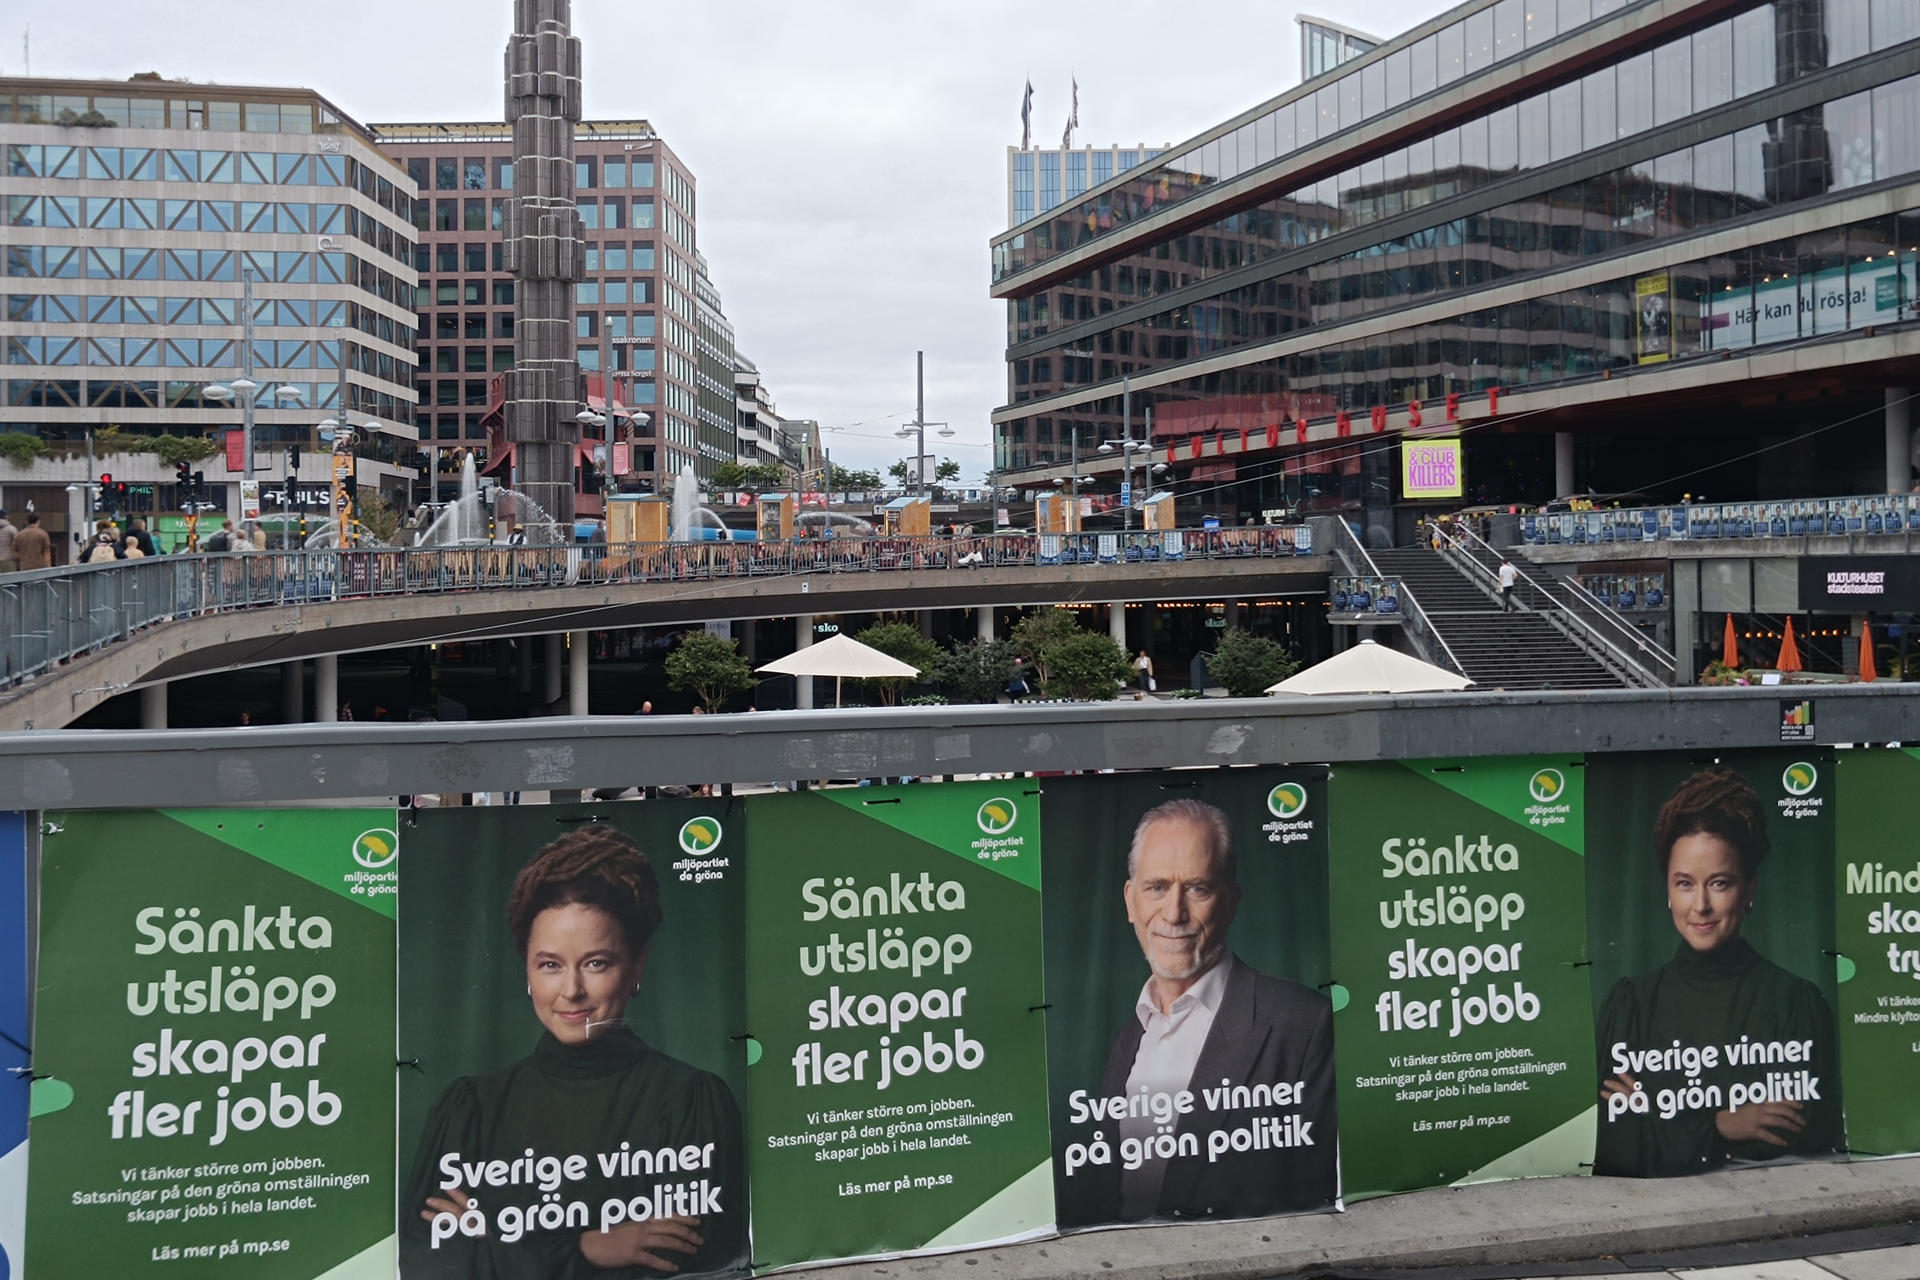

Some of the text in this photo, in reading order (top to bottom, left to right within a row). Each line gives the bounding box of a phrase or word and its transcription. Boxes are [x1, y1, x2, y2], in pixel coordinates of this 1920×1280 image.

[1735, 309, 1760, 325] Här
[1765, 301, 1791, 319] kan
[1799, 297, 1815, 313] du
[1167, 386, 1500, 462] KULTURHUSET
[1409, 451, 1454, 465] & CLUB
[1409, 465, 1455, 486] KILLERS
[26, 499, 35, 512] 4
[1827, 571, 1885, 583] KULTURHUSET
[1827, 583, 1884, 594] stadsteatern
[818, 622, 838, 632] sko
[1524, 805, 1570, 817] miljöpartiet
[1778, 798, 1823, 810] miljöpartiet
[1783, 807, 1818, 819] de gröna
[1262, 820, 1313, 834] miljöpartiet
[1529, 815, 1565, 827] de gröna
[971, 836, 1024, 852] miljöpartiet
[1268, 831, 1308, 844] de gröna
[673, 857, 729, 872] miljöpartiet
[978, 848, 1018, 861] de gröna
[1381, 835, 1518, 878] Sänkta
[351, 883, 365, 894] de
[679, 870, 723, 883] de gröna
[802, 872, 966, 921] Sänkta
[1379, 885, 1525, 932] utsläpp
[135, 904, 332, 955] Sänkta
[1868, 902, 1920, 934] ska
[800, 927, 972, 977] utsläpp
[1388, 938, 1522, 984] skapar
[1887, 943, 1920, 981] try
[127, 965, 336, 1021] utsläpp
[1877, 996, 1888, 1007] Vi
[808, 986, 967, 1033] skapar
[1375, 982, 1540, 1037] fler jobb
[1854, 1012, 1889, 1024] Mindre
[132, 1028, 326, 1082] skapar
[792, 1029, 985, 1090] fler jobb
[1390, 1047, 1534, 1067] Vi tänker större om jobben.
[1611, 1035, 1813, 1077] Sverige vinner
[1356, 1060, 1566, 1088] Satsningar på den gröna omställningen
[1069, 1078, 1305, 1124] Sverige vinner
[1395, 1080, 1530, 1102] skapar jobb i hela landet.
[1608, 1070, 1821, 1122] på grön politik
[108, 1079, 342, 1145] fler jobb
[807, 1098, 975, 1125] Vi tänker större om jobben.
[1413, 1115, 1511, 1132] Läs mer på mp.se
[768, 1111, 1013, 1149] Satsningar på den gröna omställningen
[815, 1134, 971, 1163] skapar jobb i hela landet.
[1065, 1114, 1314, 1177] på grön politik
[121, 1156, 325, 1182] Vi tänker större om jobben.
[440, 1141, 715, 1191] Sverige vinner
[72, 1172, 370, 1206] Satsningar på den gröna omställningen
[839, 1174, 953, 1196] Läs mer på mp.se
[127, 1196, 317, 1224] skapar jobb i hela landet.
[431, 1179, 723, 1249] på grön politik
[152, 1239, 290, 1261] Läs mer på mp.se
